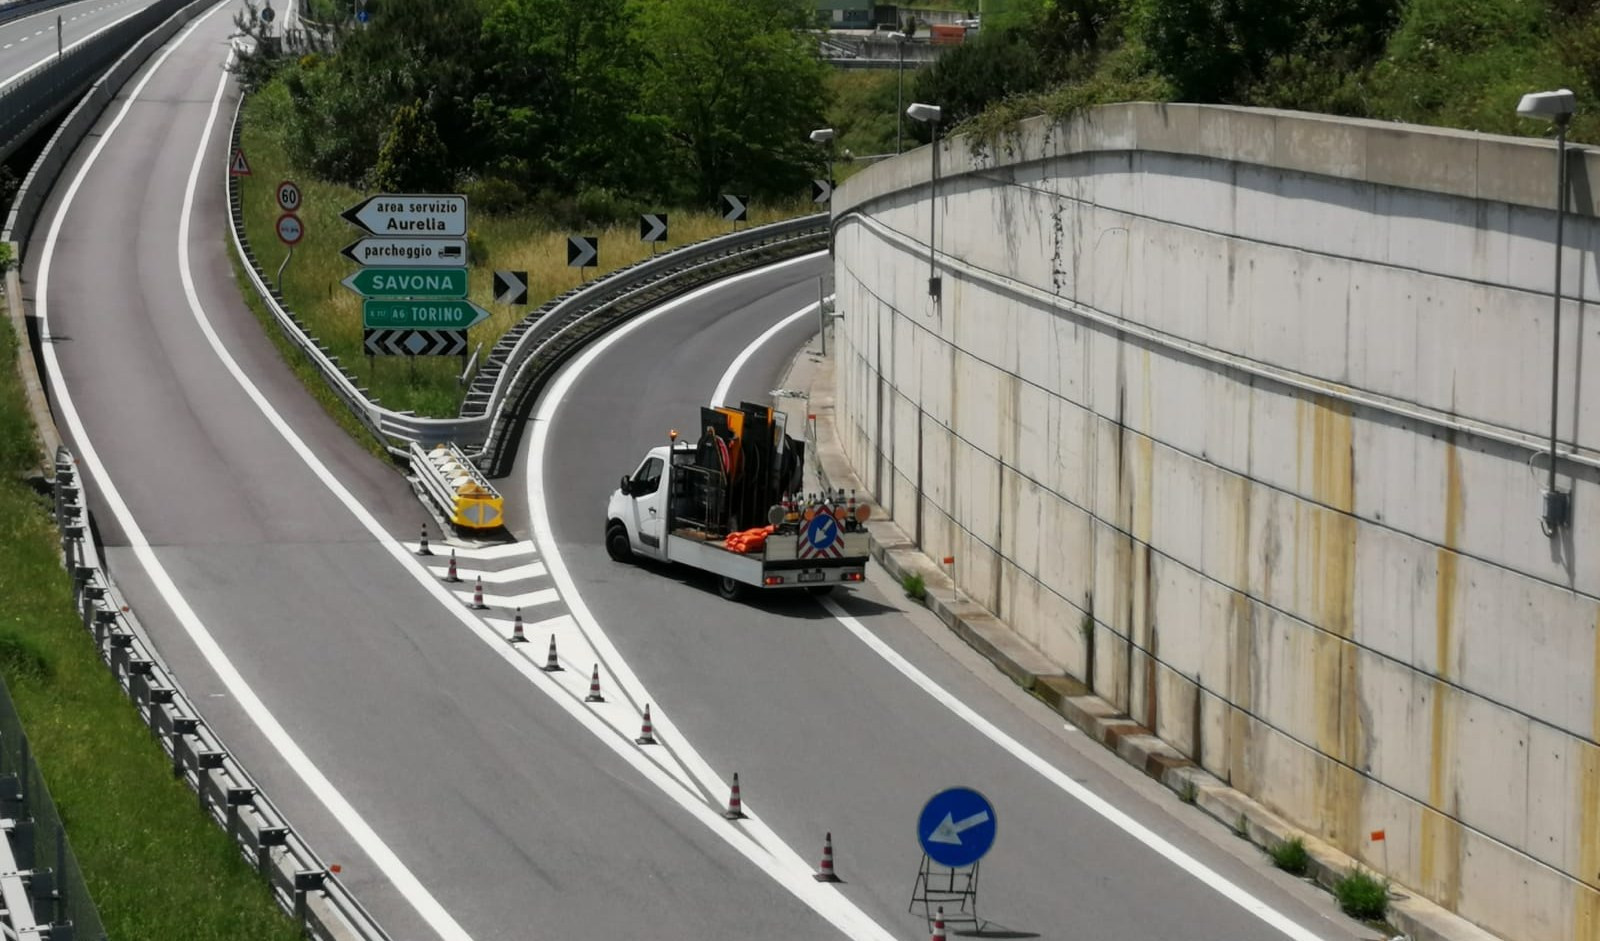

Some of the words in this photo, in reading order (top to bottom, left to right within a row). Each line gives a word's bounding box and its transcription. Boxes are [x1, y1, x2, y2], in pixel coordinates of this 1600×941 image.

[282, 189, 296, 203] 60
[377, 202, 404, 213] area
[409, 202, 458, 213] servizio
[387, 218, 446, 230] Aurelia
[365, 244, 432, 259] parcheggio
[372, 275, 453, 290] SAVONA
[392, 308, 405, 319] A6
[412, 307, 462, 321] TORINO
